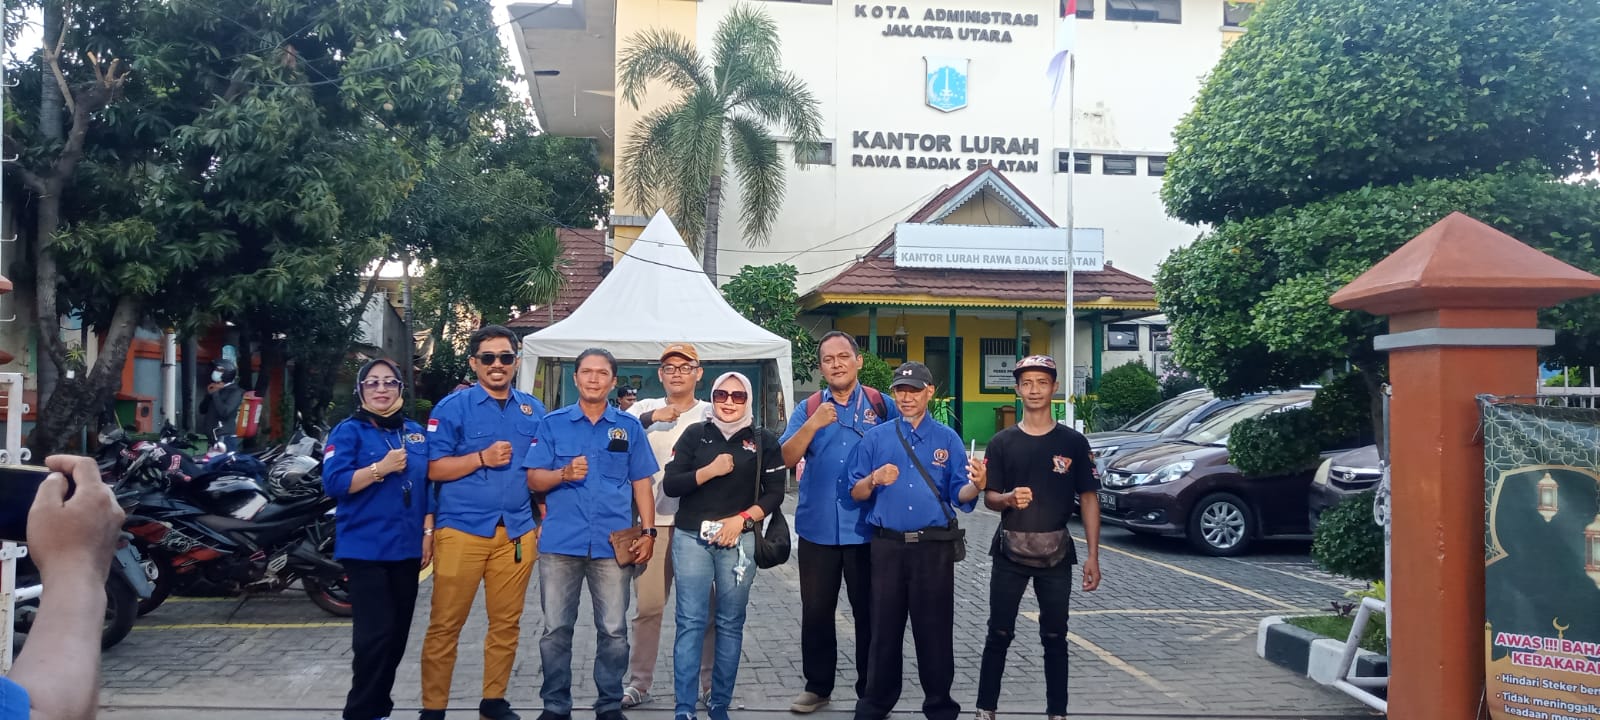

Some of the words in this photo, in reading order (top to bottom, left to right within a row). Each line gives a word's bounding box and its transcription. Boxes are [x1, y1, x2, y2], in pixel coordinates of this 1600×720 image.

[855, 5, 909, 19] KOTA
[923, 8, 1039, 26] ADMINISTRASI
[882, 24, 953, 39] JAKARTA
[958, 28, 1012, 43] UTARA
[852, 130, 952, 152] KANTOR
[960, 135, 1039, 155] LURAH
[852, 154, 901, 168] RAWA
[906, 156, 960, 170] BADAK
[901, 252, 943, 263] KANTOR
[946, 253, 980, 264] LURAH
[982, 254, 1012, 265] RAWA
[1015, 255, 1048, 266] BADAK
[1495, 632, 1542, 649] AWAS
[1545, 638, 1558, 651] !!!
[1512, 651, 1600, 676] KEBAKARA
[1502, 674, 1540, 688] Hindari
[1542, 679, 1577, 692] Steker
[1502, 692, 1532, 705] Tidak
[1504, 705, 1549, 720] keadaan
